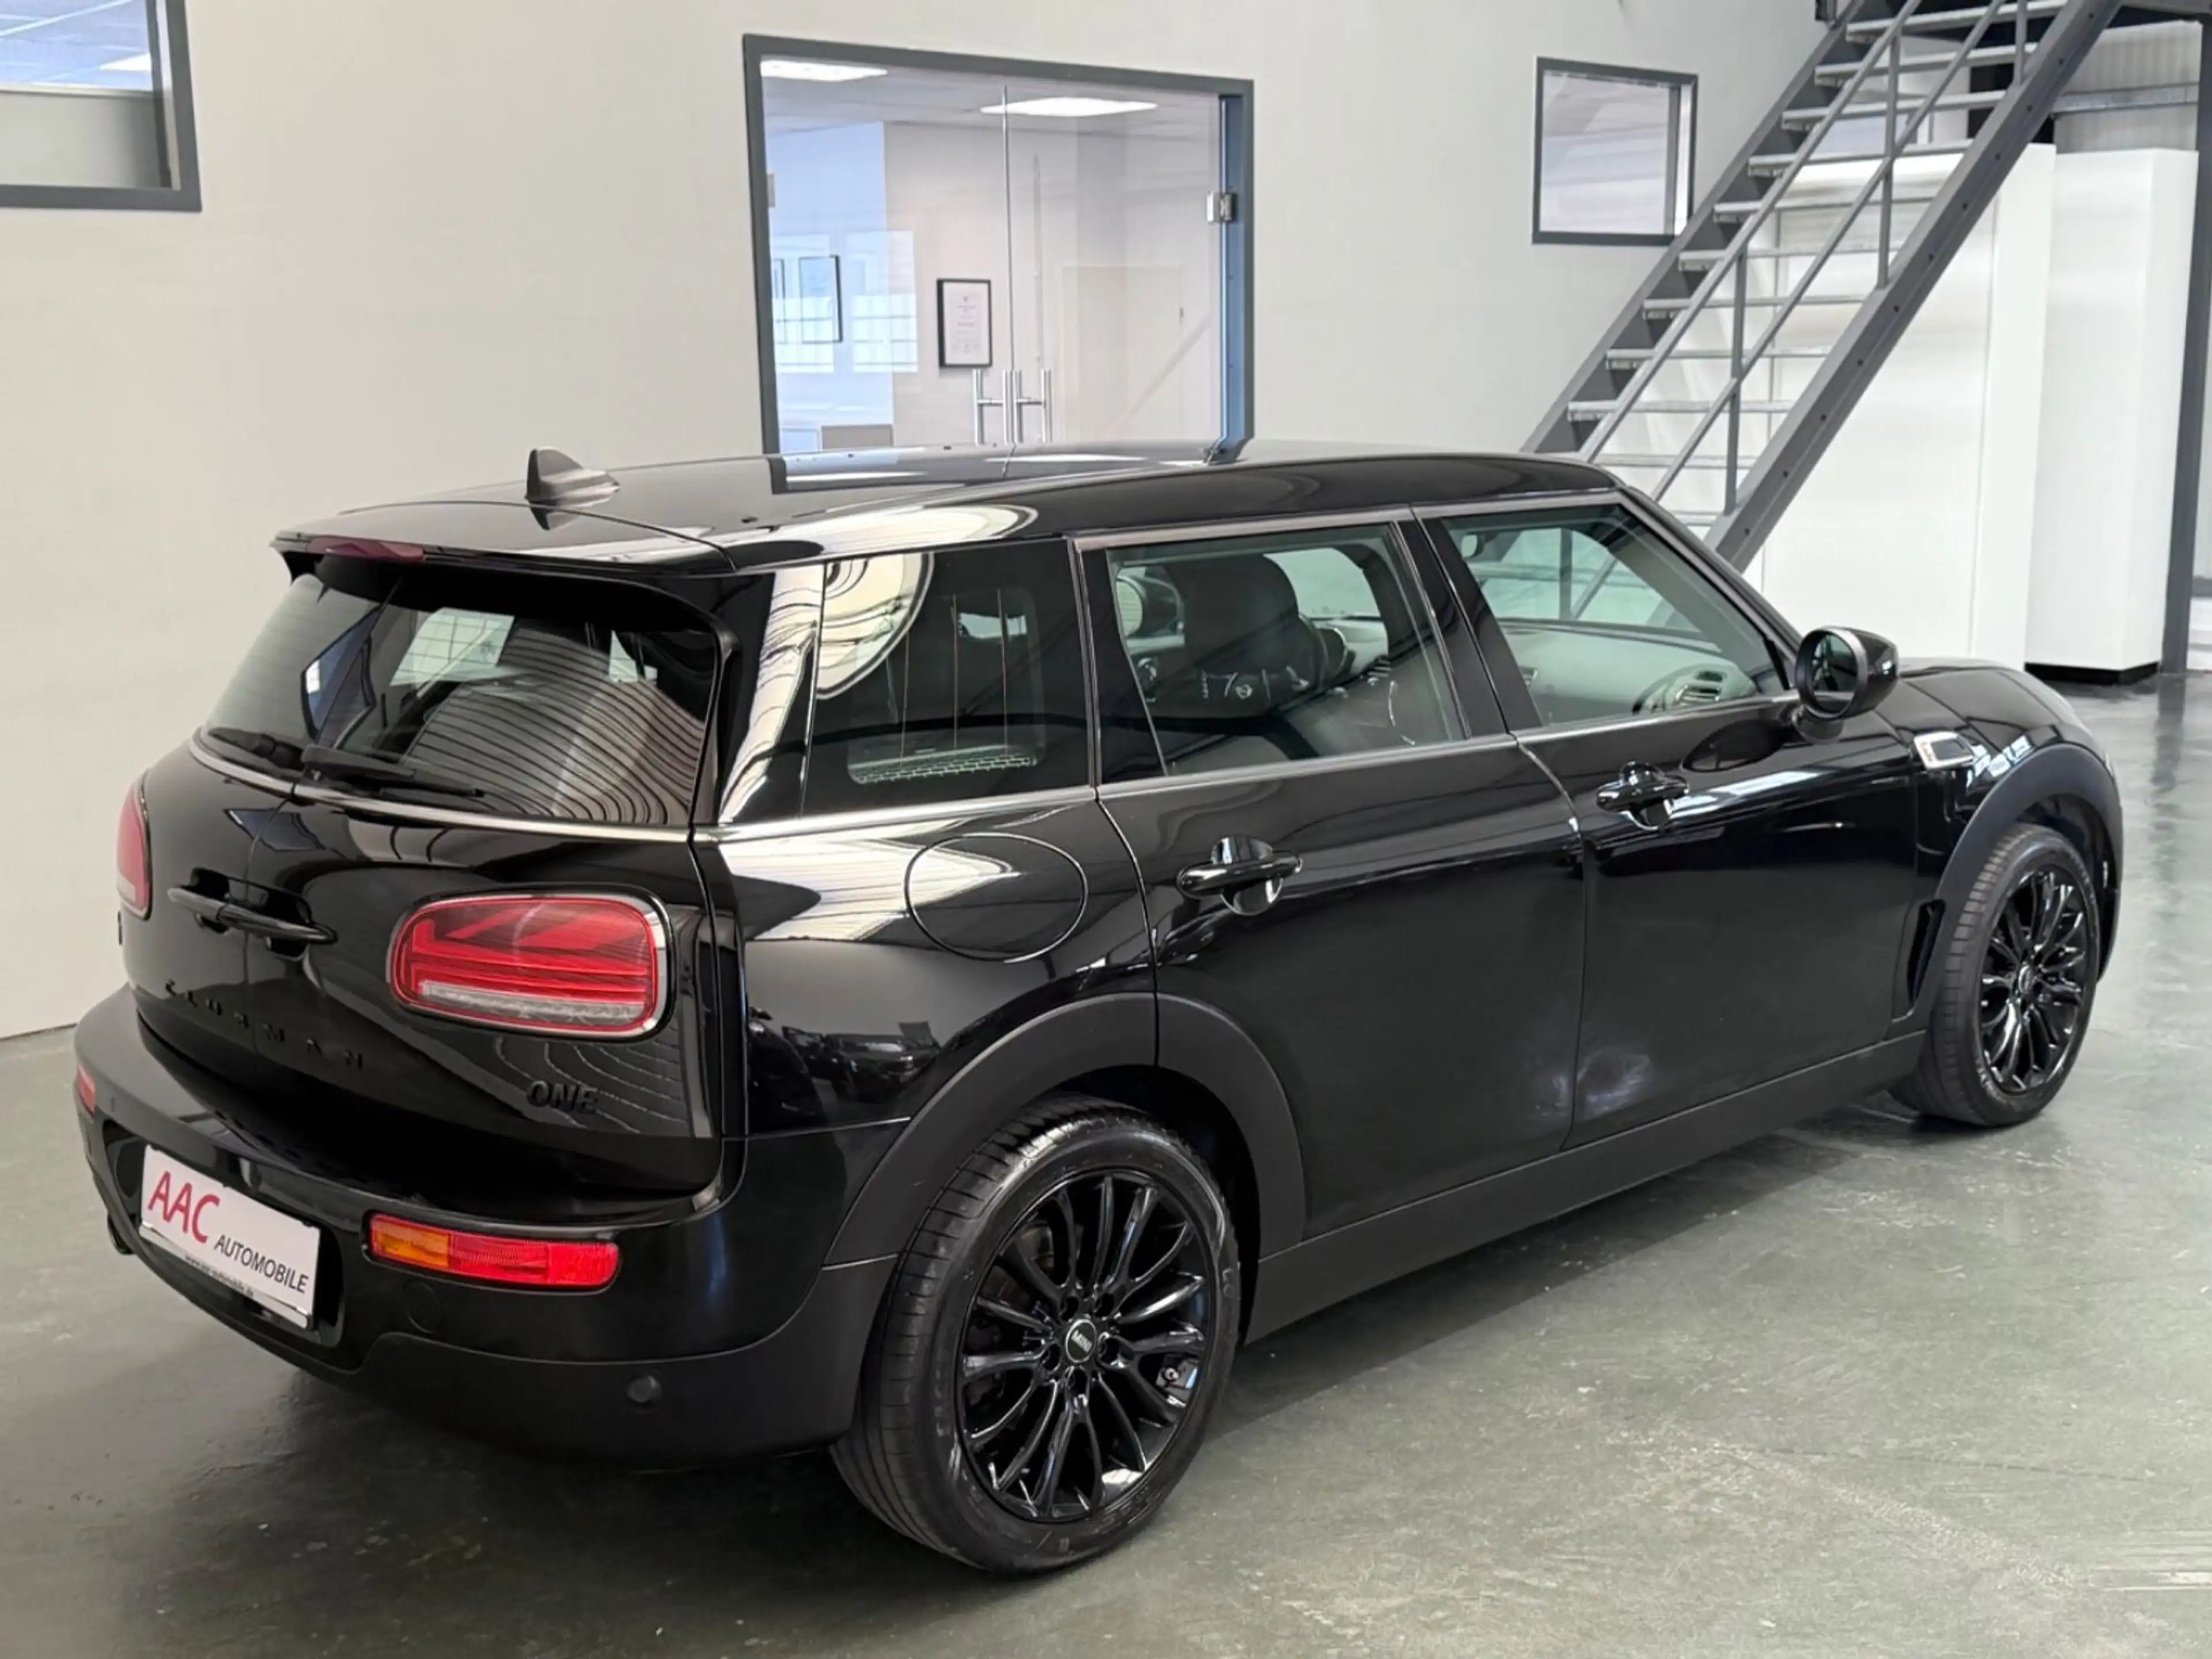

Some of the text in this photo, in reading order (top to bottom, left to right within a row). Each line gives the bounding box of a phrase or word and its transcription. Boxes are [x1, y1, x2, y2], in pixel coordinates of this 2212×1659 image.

[527, 1080, 599, 1114] ONE
[147, 1171, 221, 1244] AAC
[214, 1234, 309, 1294] AUTOMOBILE
